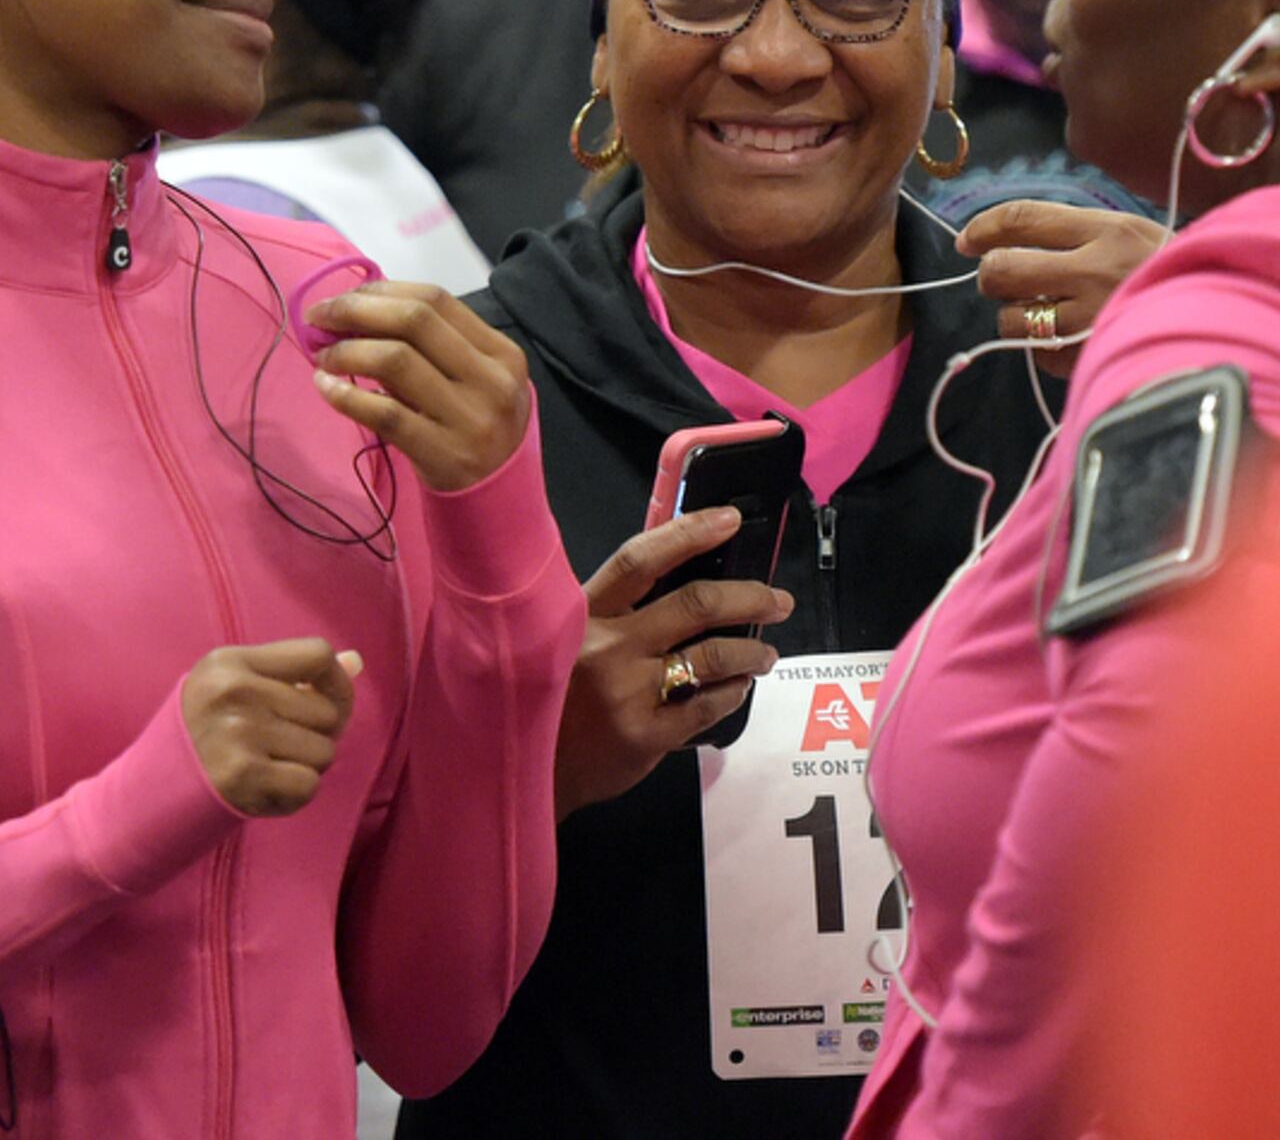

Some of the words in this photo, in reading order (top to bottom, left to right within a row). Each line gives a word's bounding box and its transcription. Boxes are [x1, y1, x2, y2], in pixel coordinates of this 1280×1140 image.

[775, 667, 813, 681] THE
[792, 760, 817, 777] 5K
[820, 759, 850, 776] ON
[734, 1007, 824, 1025] enterprise
